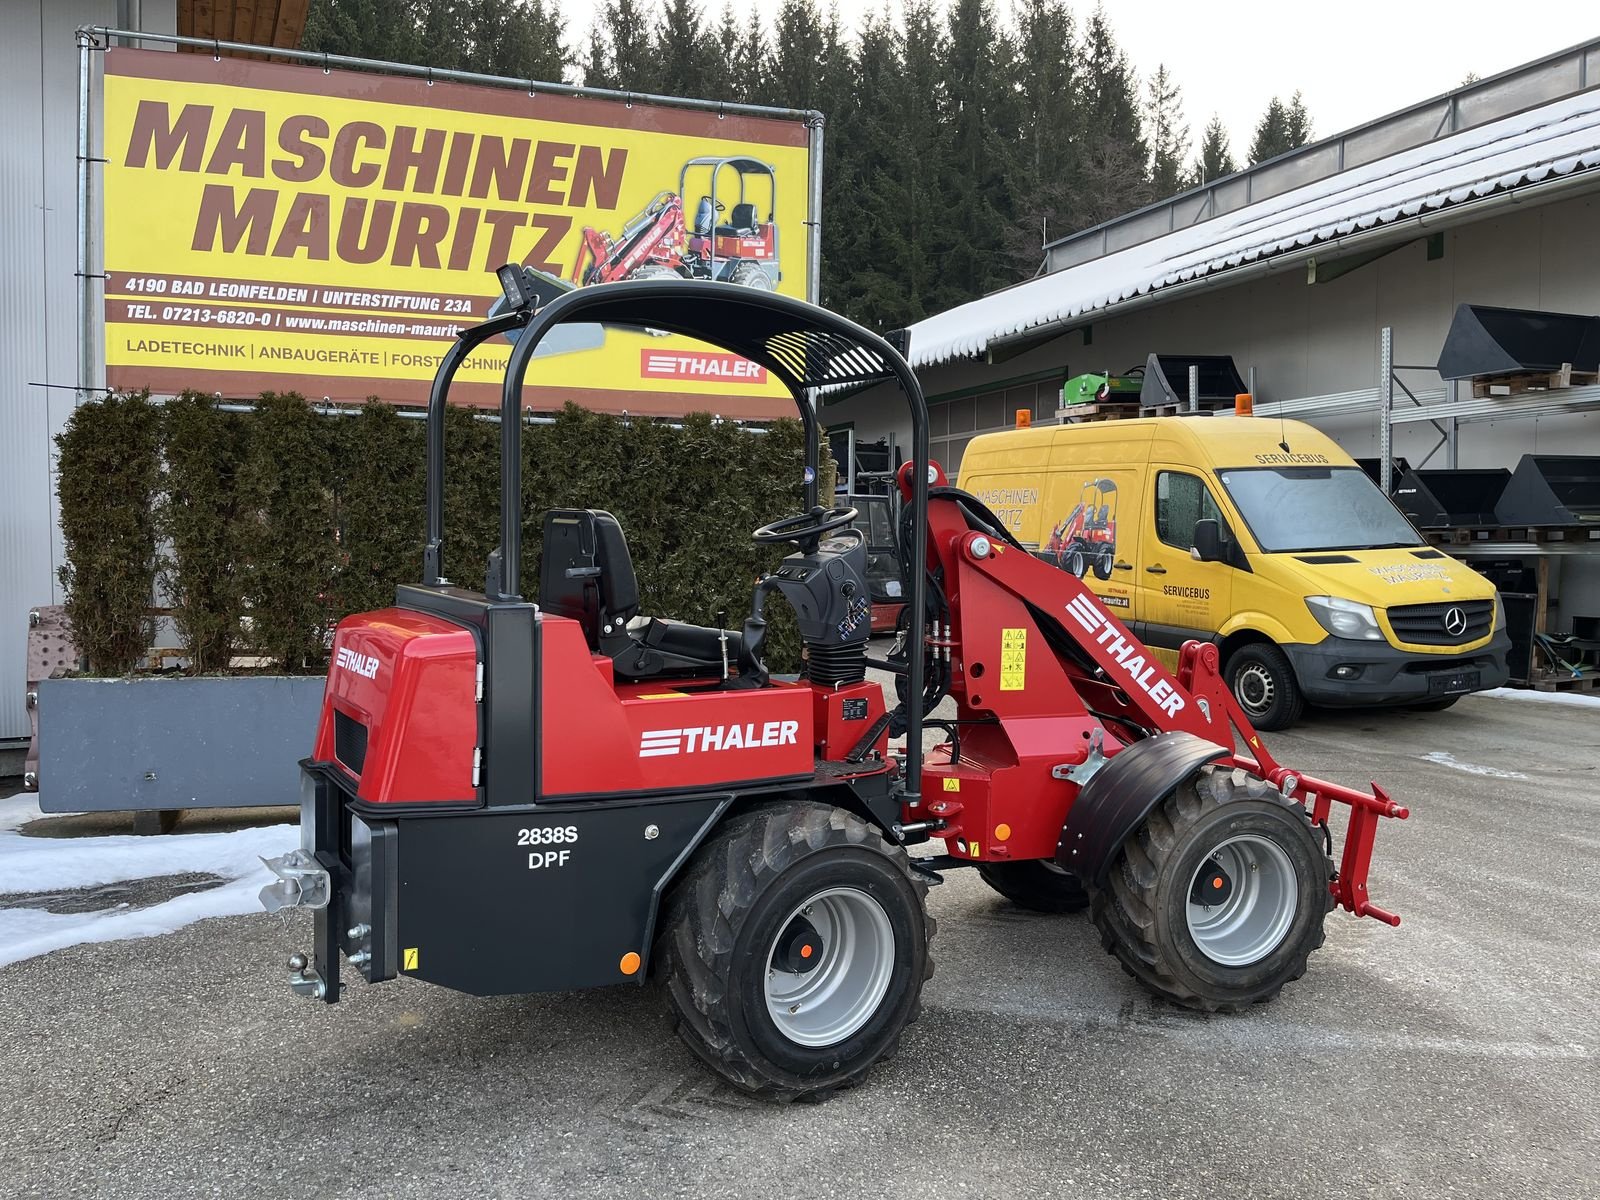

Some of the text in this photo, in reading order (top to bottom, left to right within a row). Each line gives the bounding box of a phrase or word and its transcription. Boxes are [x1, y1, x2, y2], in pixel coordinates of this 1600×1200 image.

[124, 99, 629, 211] MASCHINEN
[191, 183, 573, 280] MAURITZ
[126, 278, 472, 313] 4190 BAD LEONFELDEN UNTERSTIFTUNG 23A
[127, 304, 157, 320] TEL.
[162, 307, 271, 326] 07213-6820-0
[126, 340, 508, 371] LADETECHNIK ANBAUGERÄTE FORSTCHNIK
[677, 356, 761, 378] THALER
[1254, 453, 1329, 465] SERVICEBUS
[1163, 584, 1210, 600] SERVICEBUS
[345, 649, 380, 680] THALER
[1096, 620, 1186, 719] THALER
[681, 720, 799, 753] THALER
[517, 825, 578, 846] 2838S
[528, 849, 571, 869] DPF
